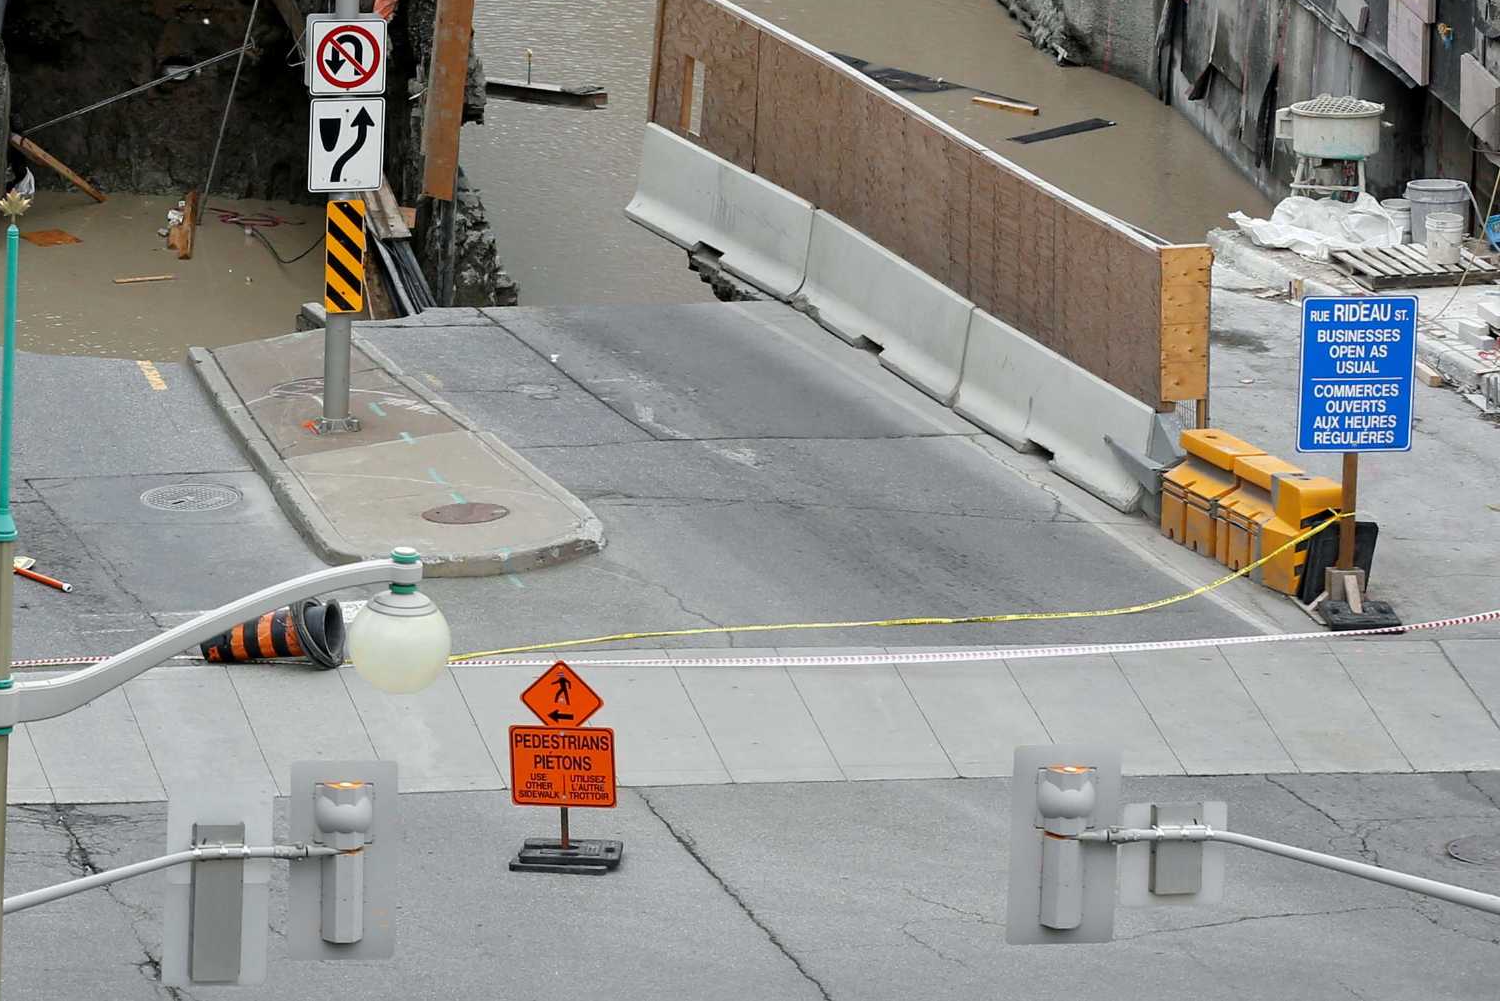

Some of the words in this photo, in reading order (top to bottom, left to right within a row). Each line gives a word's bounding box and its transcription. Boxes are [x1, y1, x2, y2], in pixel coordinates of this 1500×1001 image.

[1310, 311, 1330, 322] RUE
[1334, 303, 1391, 322] RIDEAU
[1394, 309, 1409, 321] ST.
[1317, 329, 1400, 342] BUSINESSES
[1329, 345, 1365, 358] OPEN
[1369, 345, 1388, 358] AS
[1336, 361, 1379, 374] USUAL
[1314, 384, 1399, 397] COMMERCES
[1325, 400, 1386, 413] OUVERTS
[1313, 416, 1340, 429] AUX
[1345, 415, 1397, 428] HEURES
[515, 733, 609, 751] PEDESTRIANS
[534, 752, 592, 771] PIÉTONS
[530, 773, 547, 781] USE
[570, 775, 606, 783] UTILISEZ
[525, 781, 553, 790] OTHER
[571, 783, 605, 792] L'AUTRE
[518, 790, 560, 799] SIDEWALK
[569, 792, 609, 800] TROTTOIR
